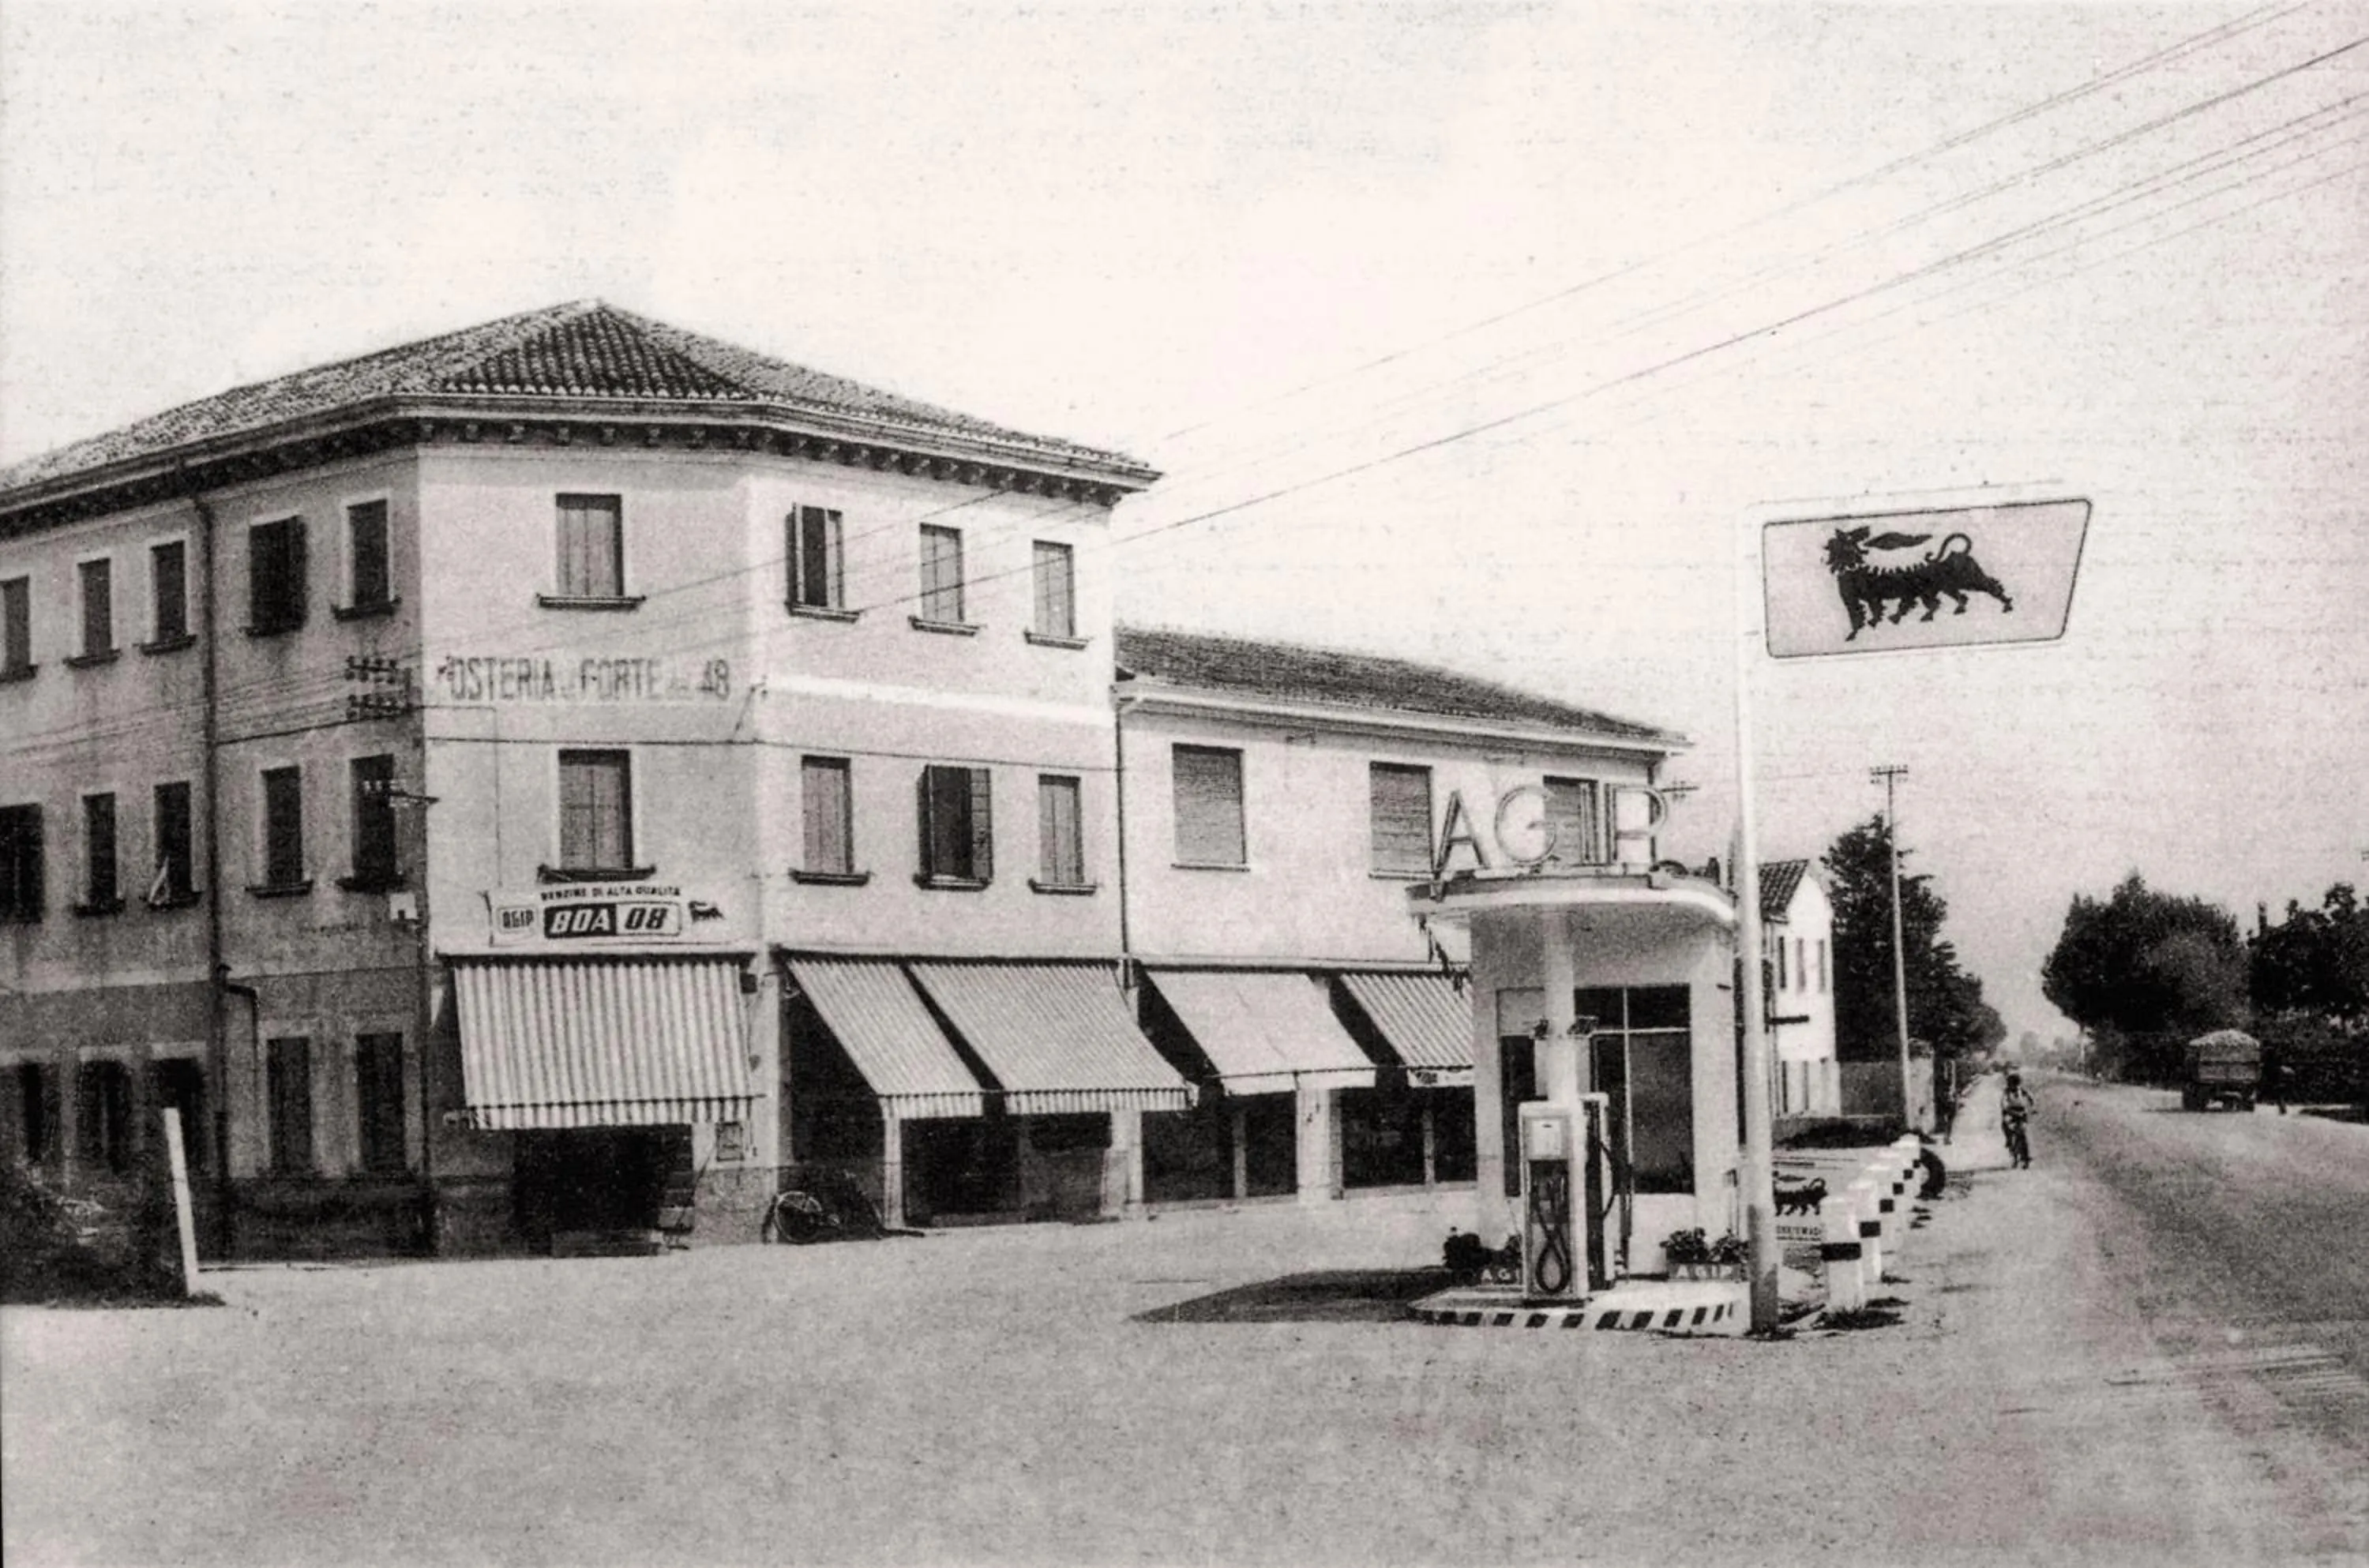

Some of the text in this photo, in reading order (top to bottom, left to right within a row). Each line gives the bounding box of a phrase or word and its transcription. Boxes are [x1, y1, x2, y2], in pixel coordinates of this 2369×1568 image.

[450, 657, 555, 700] OSTERIA
[1433, 783, 1669, 868] AGIP
[606, 884, 633, 898] ALTA
[502, 909, 534, 929] AGIP
[1481, 1267, 1521, 1282] AGI
[1675, 1263, 1735, 1280] AGIP
